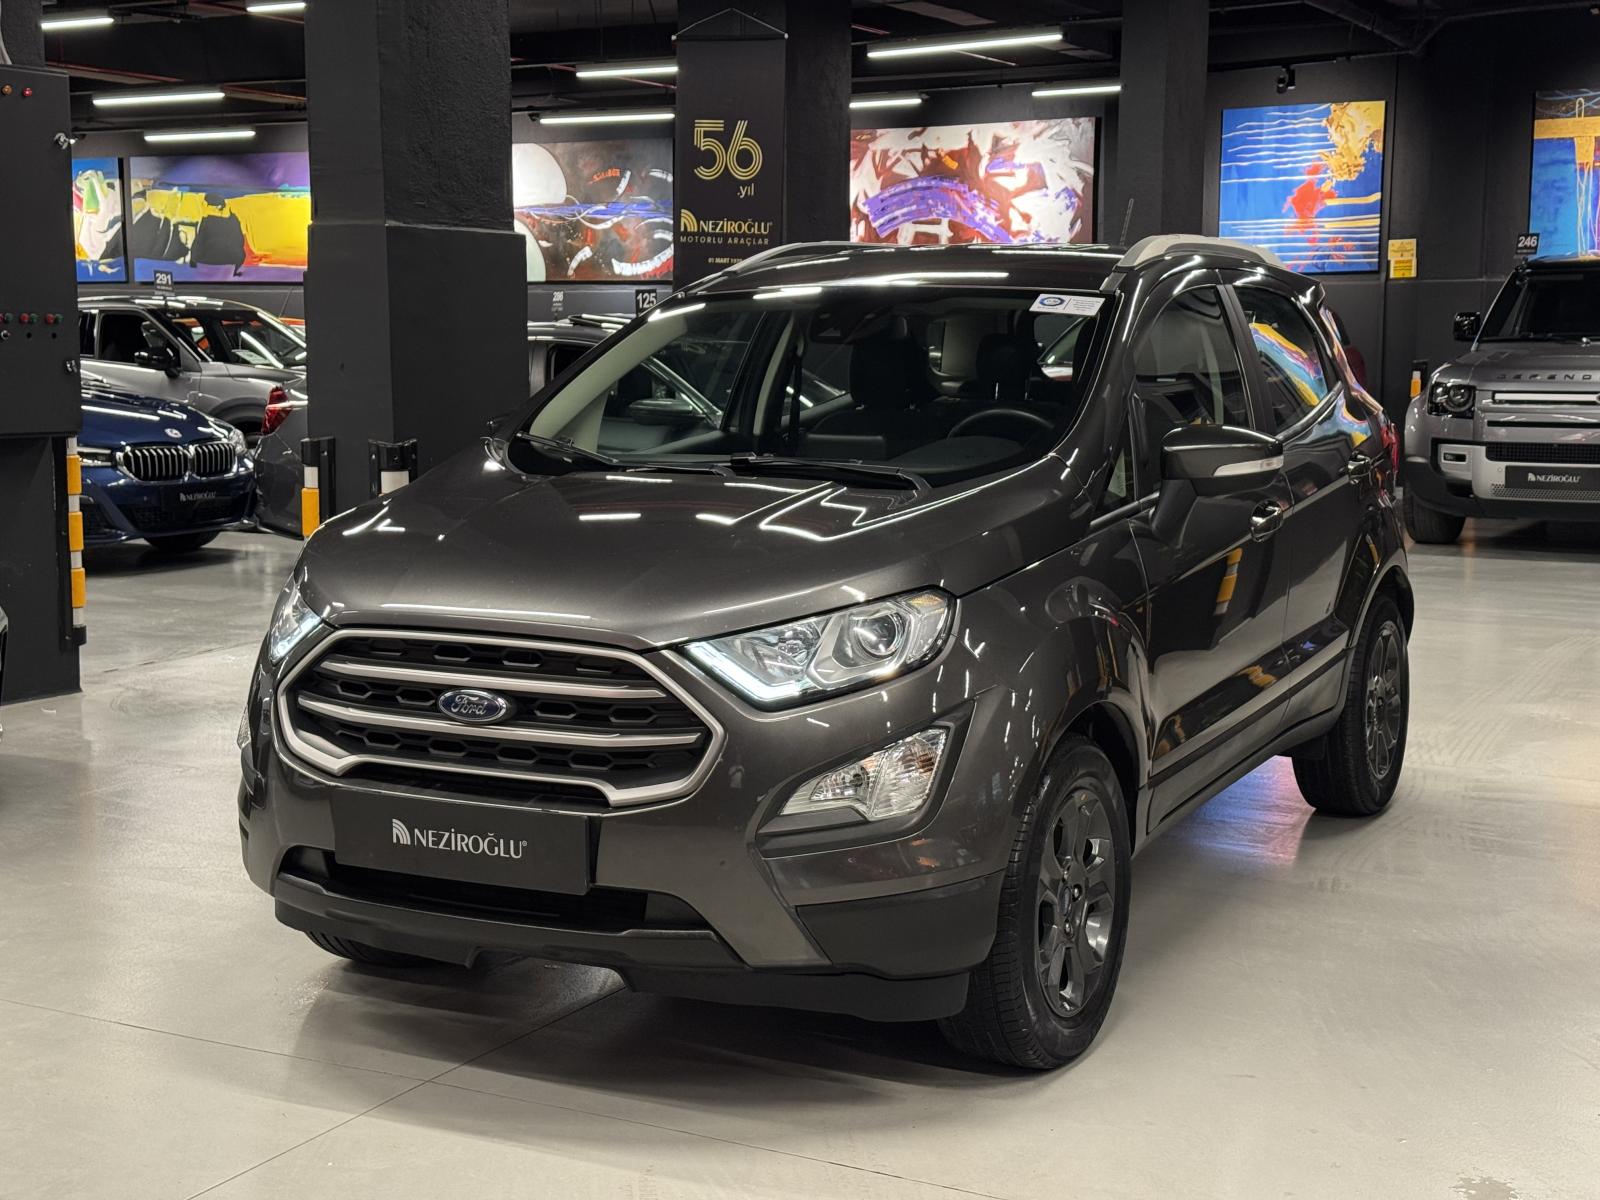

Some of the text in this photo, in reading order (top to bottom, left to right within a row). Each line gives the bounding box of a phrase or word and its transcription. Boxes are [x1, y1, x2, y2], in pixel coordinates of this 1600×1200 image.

[694, 119, 763, 180] 56
[699, 218, 770, 235] NEZİROĞLU
[680, 235, 769, 247] MOTORLU ARAÇLAR
[1518, 236, 1537, 248] 246
[155, 273, 172, 285] 291
[636, 292, 657, 309] 125
[1496, 373, 1600, 381] DEFEND
[451, 694, 488, 715] Ford
[414, 828, 522, 859] NEZİROĞLU
